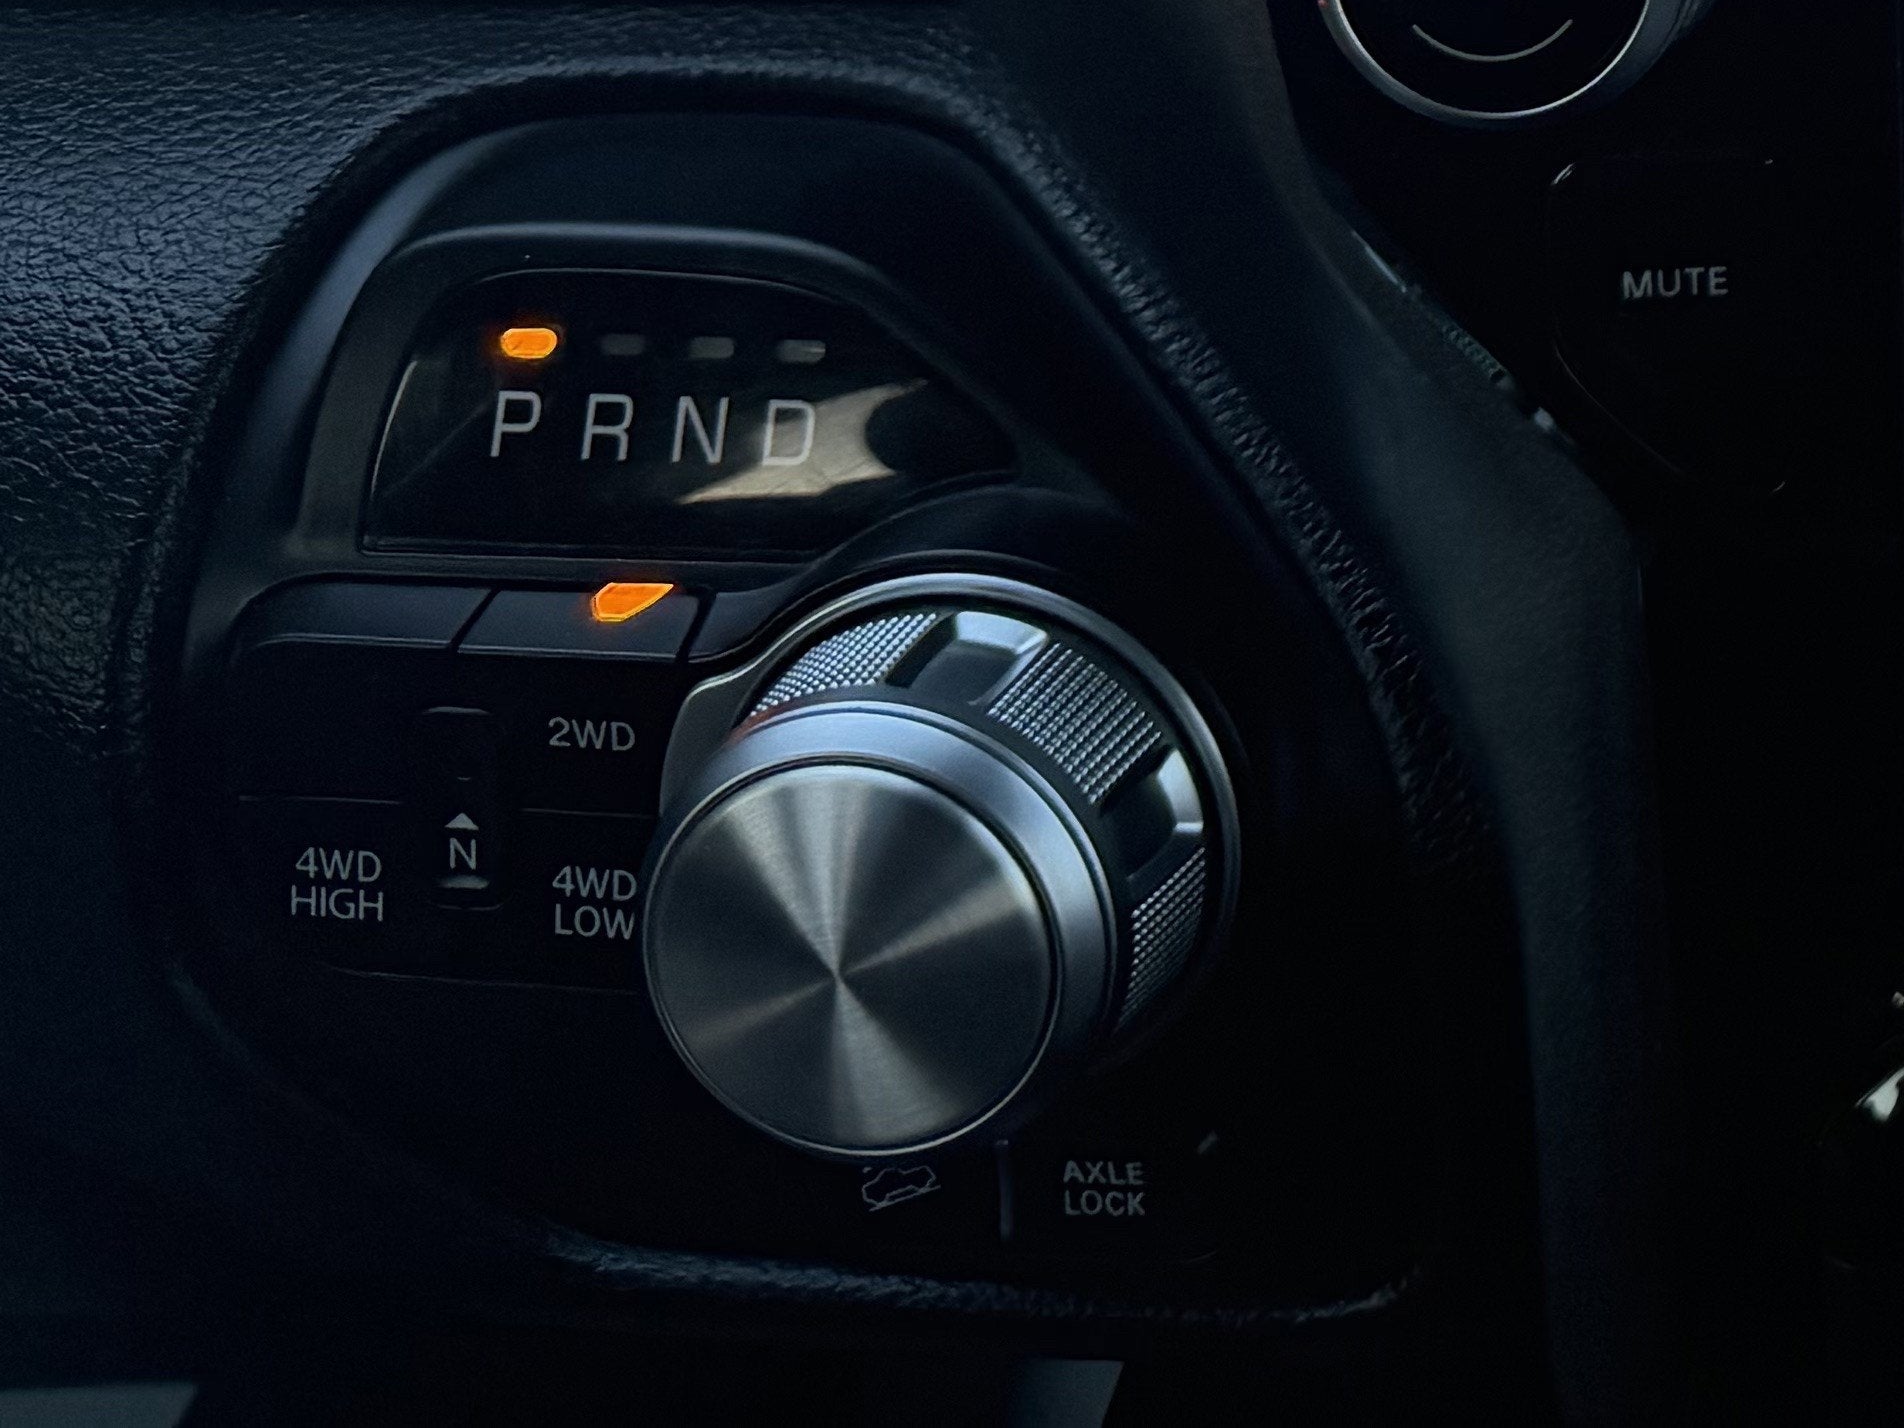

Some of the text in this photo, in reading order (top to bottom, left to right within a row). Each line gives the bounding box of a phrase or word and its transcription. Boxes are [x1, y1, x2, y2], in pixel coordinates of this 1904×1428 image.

[1622, 266, 1728, 299] MUTE
[548, 716, 636, 751] 2WD
[295, 846, 382, 883] 4WD
[449, 837, 477, 870] N
[551, 865, 637, 901] 4WD
[290, 884, 384, 922] HIGH
[554, 903, 635, 940] LOW
[1062, 1160, 1144, 1186] AXLE
[1064, 1189, 1146, 1217] LOCK
